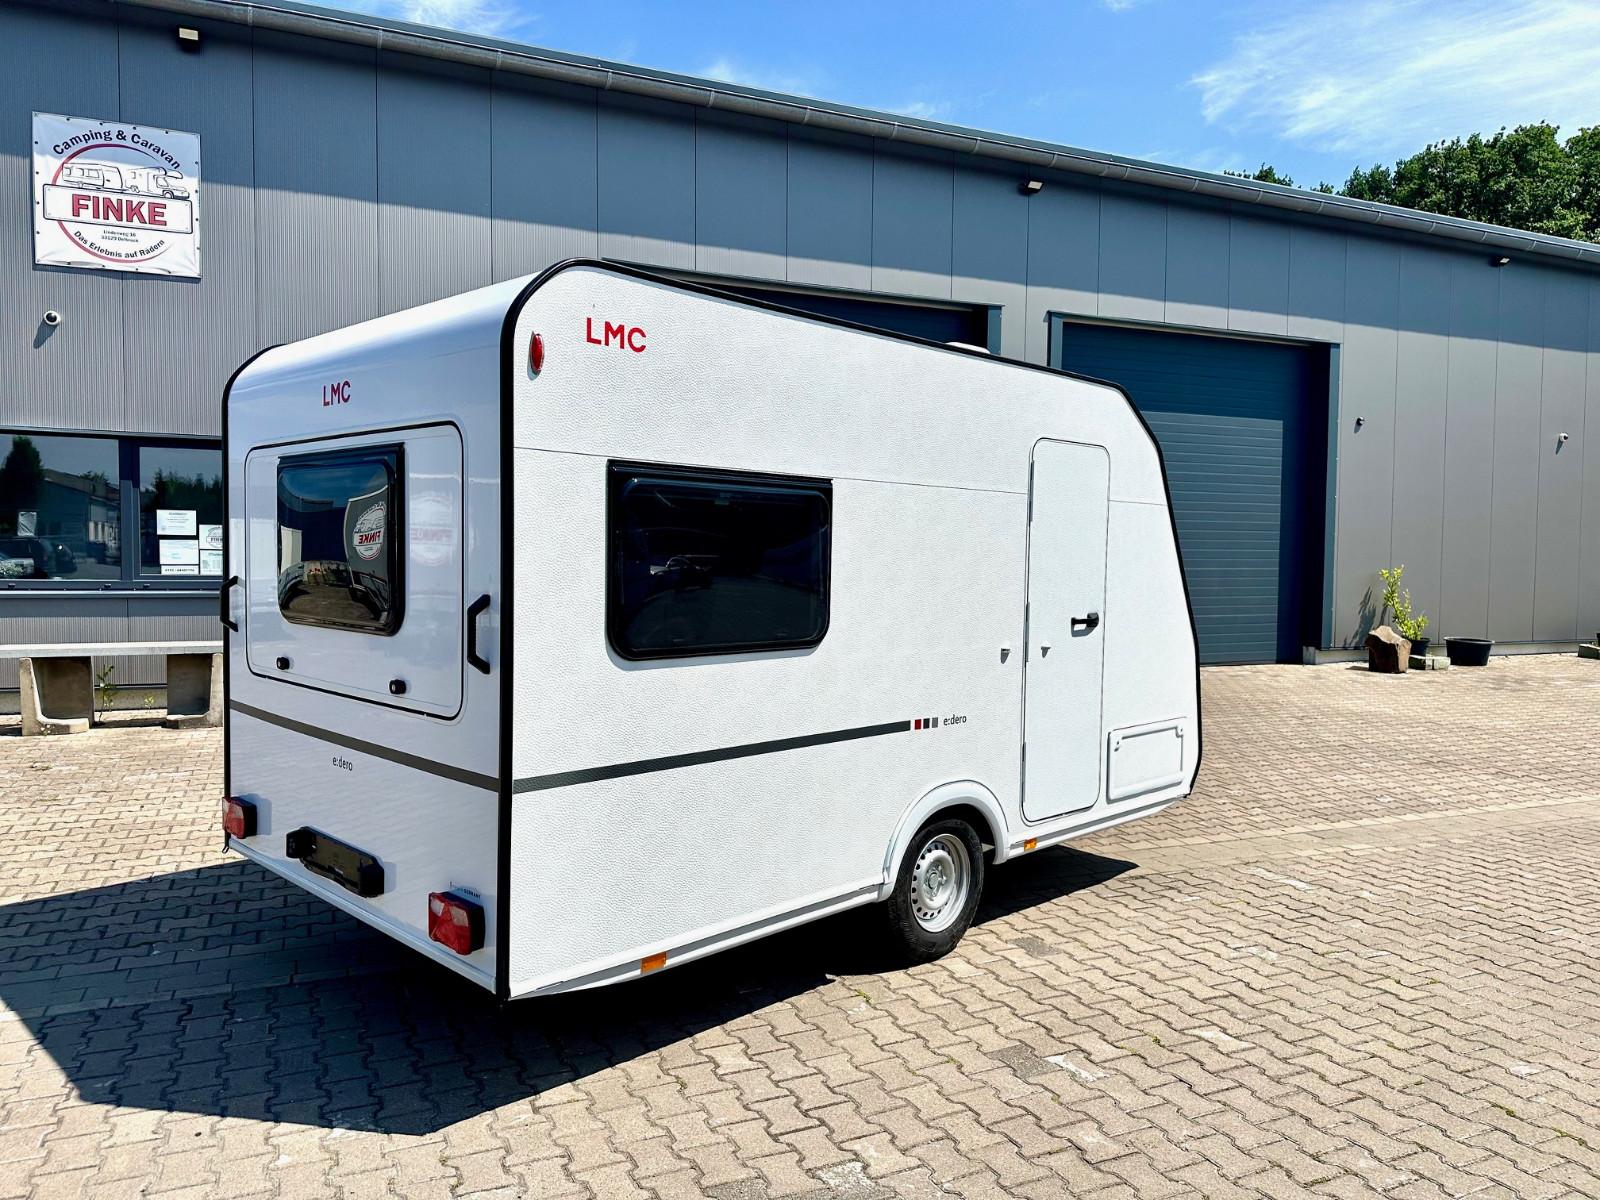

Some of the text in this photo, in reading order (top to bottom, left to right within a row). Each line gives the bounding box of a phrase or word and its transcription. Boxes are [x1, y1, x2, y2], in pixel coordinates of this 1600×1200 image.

[53, 129, 180, 170] Camping & Caravan
[71, 193, 167, 226] FINKE
[74, 230, 89, 245] Das
[88, 242, 123, 258] Erlebnis
[124, 250, 138, 259] auf
[586, 316, 647, 353] LMC
[322, 380, 351, 407] LMC
[943, 713, 967, 726] e:dero
[332, 755, 353, 771] e:dero
